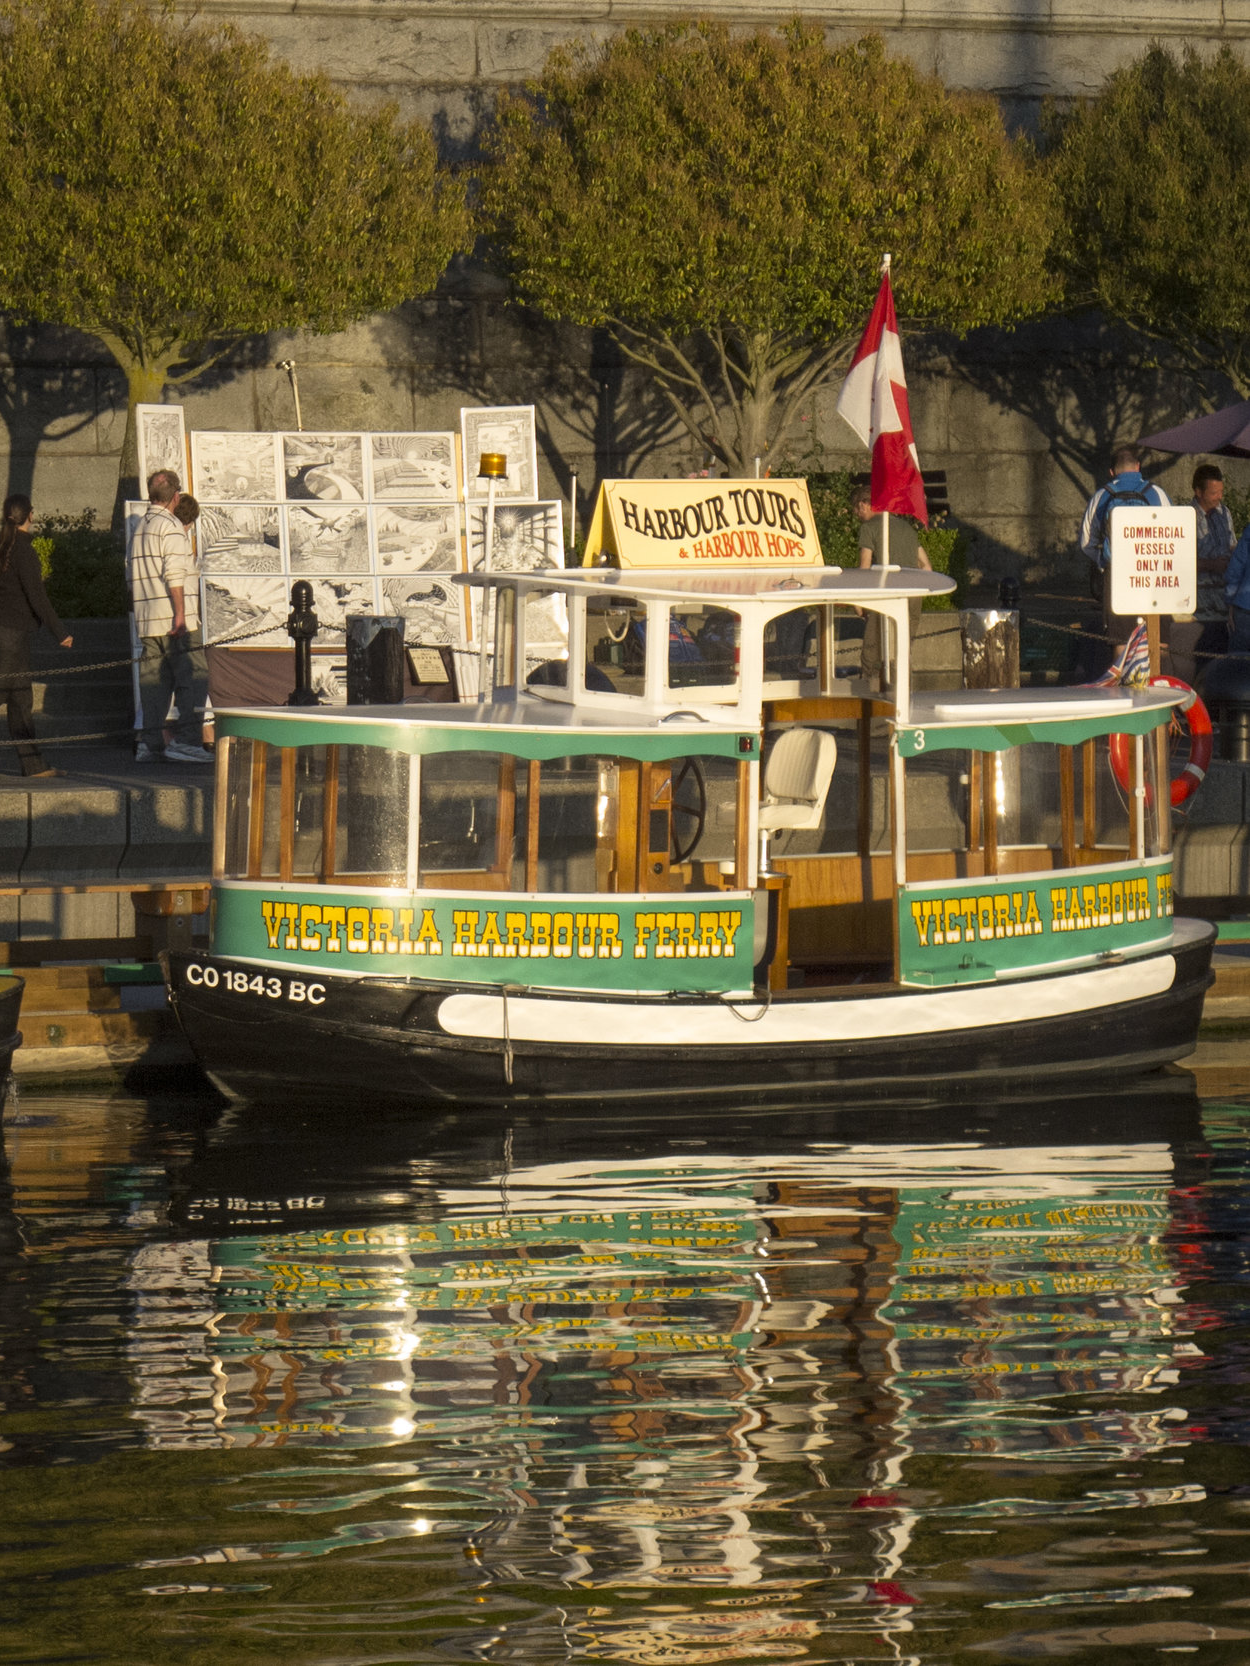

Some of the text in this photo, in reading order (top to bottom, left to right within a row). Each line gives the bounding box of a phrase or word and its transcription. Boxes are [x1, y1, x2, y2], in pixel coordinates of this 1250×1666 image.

[619, 488, 806, 541] HARBOUR TOURS
[679, 530, 806, 559] & HARBOUR HOPS
[1123, 526, 1185, 539] COMMERCIAL
[1134, 543, 1175, 555] VESSELS
[1136, 559, 1173, 571] ONLY IN
[1129, 576, 1180, 588] THIS AREA
[914, 730, 925, 750] 3
[910, 872, 1174, 947] VICTORIA HARBOUR FE
[261, 900, 742, 959] VICTORIA HARBOUR FERRY
[222, 970, 282, 998] 1843
[288, 980, 326, 1005] BC
